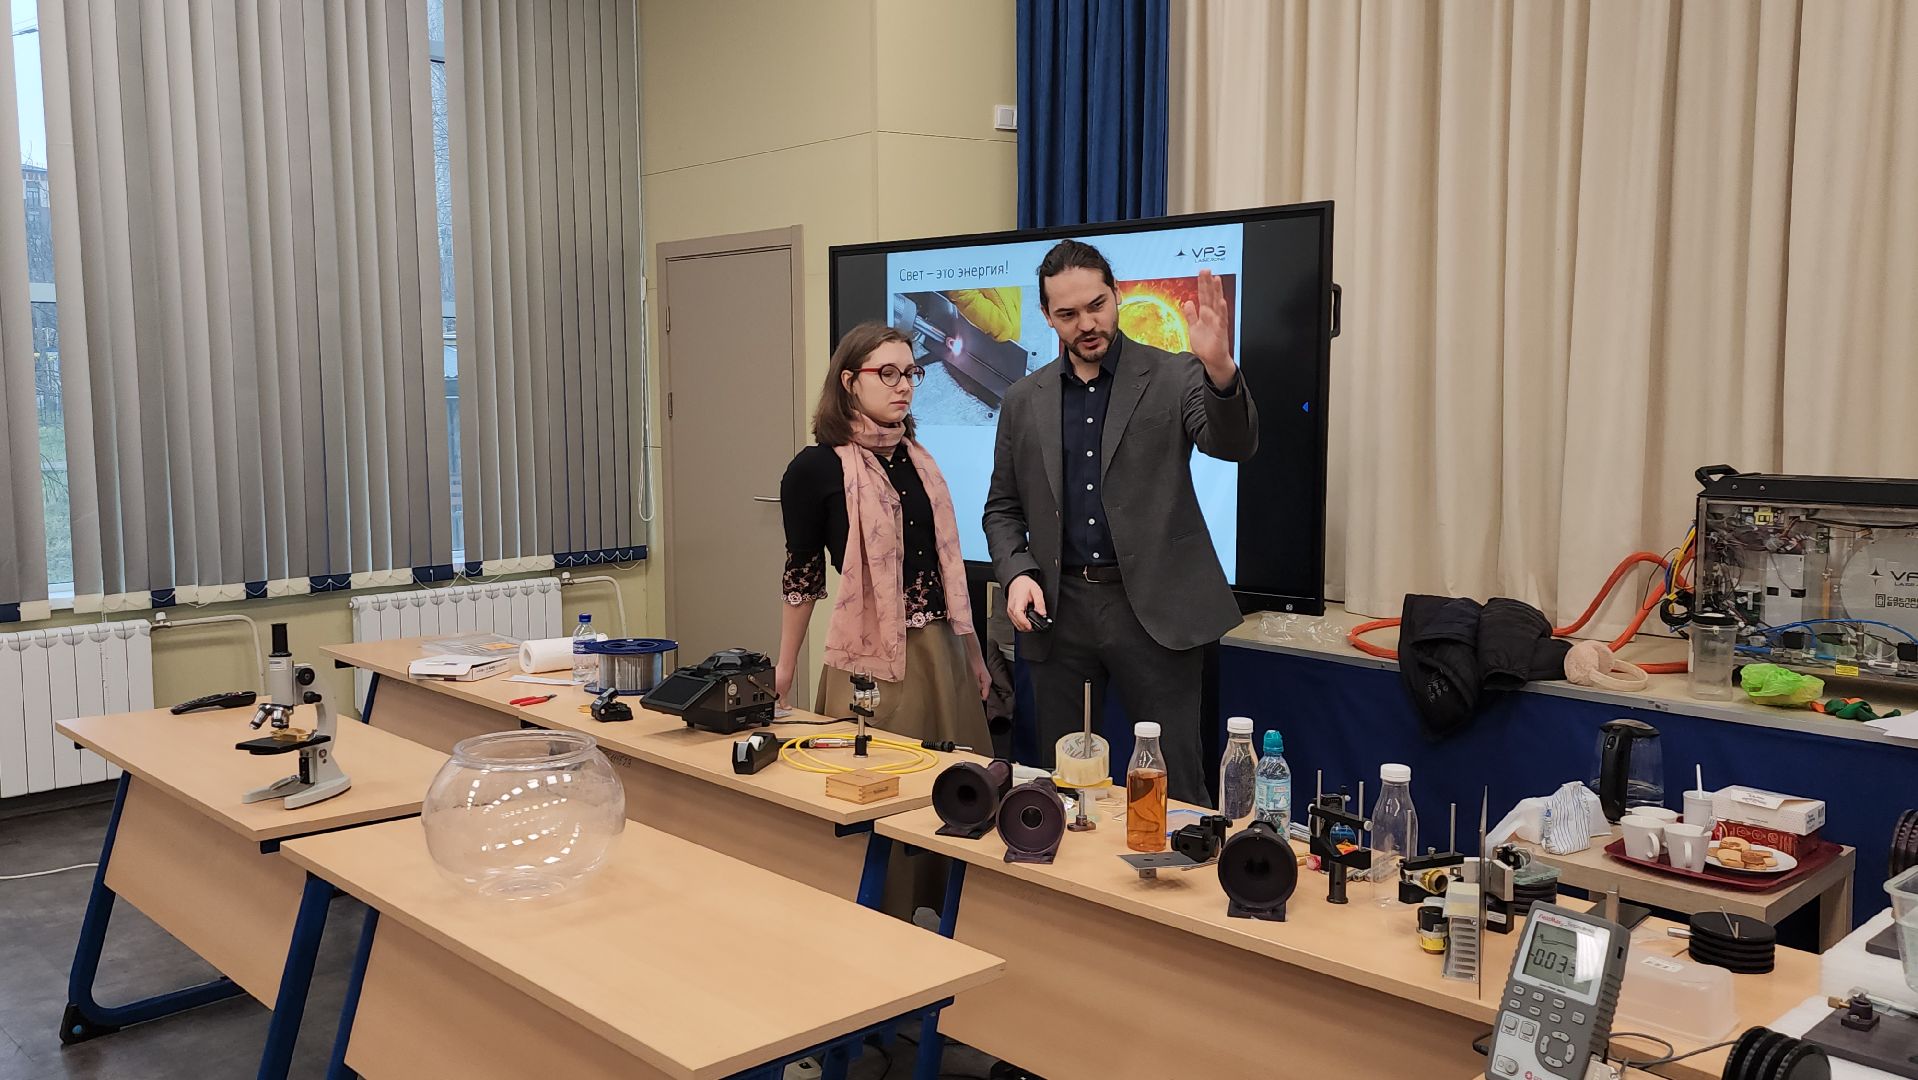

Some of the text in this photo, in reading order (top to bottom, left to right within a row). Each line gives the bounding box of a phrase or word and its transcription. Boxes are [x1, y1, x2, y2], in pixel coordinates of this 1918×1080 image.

[1191, 245, 1226, 258] VPG
[899, 268, 924, 282] Свет
[936, 268, 955, 280] это
[958, 259, 1009, 280] энергия!
[1889, 570, 1918, 582] VP
